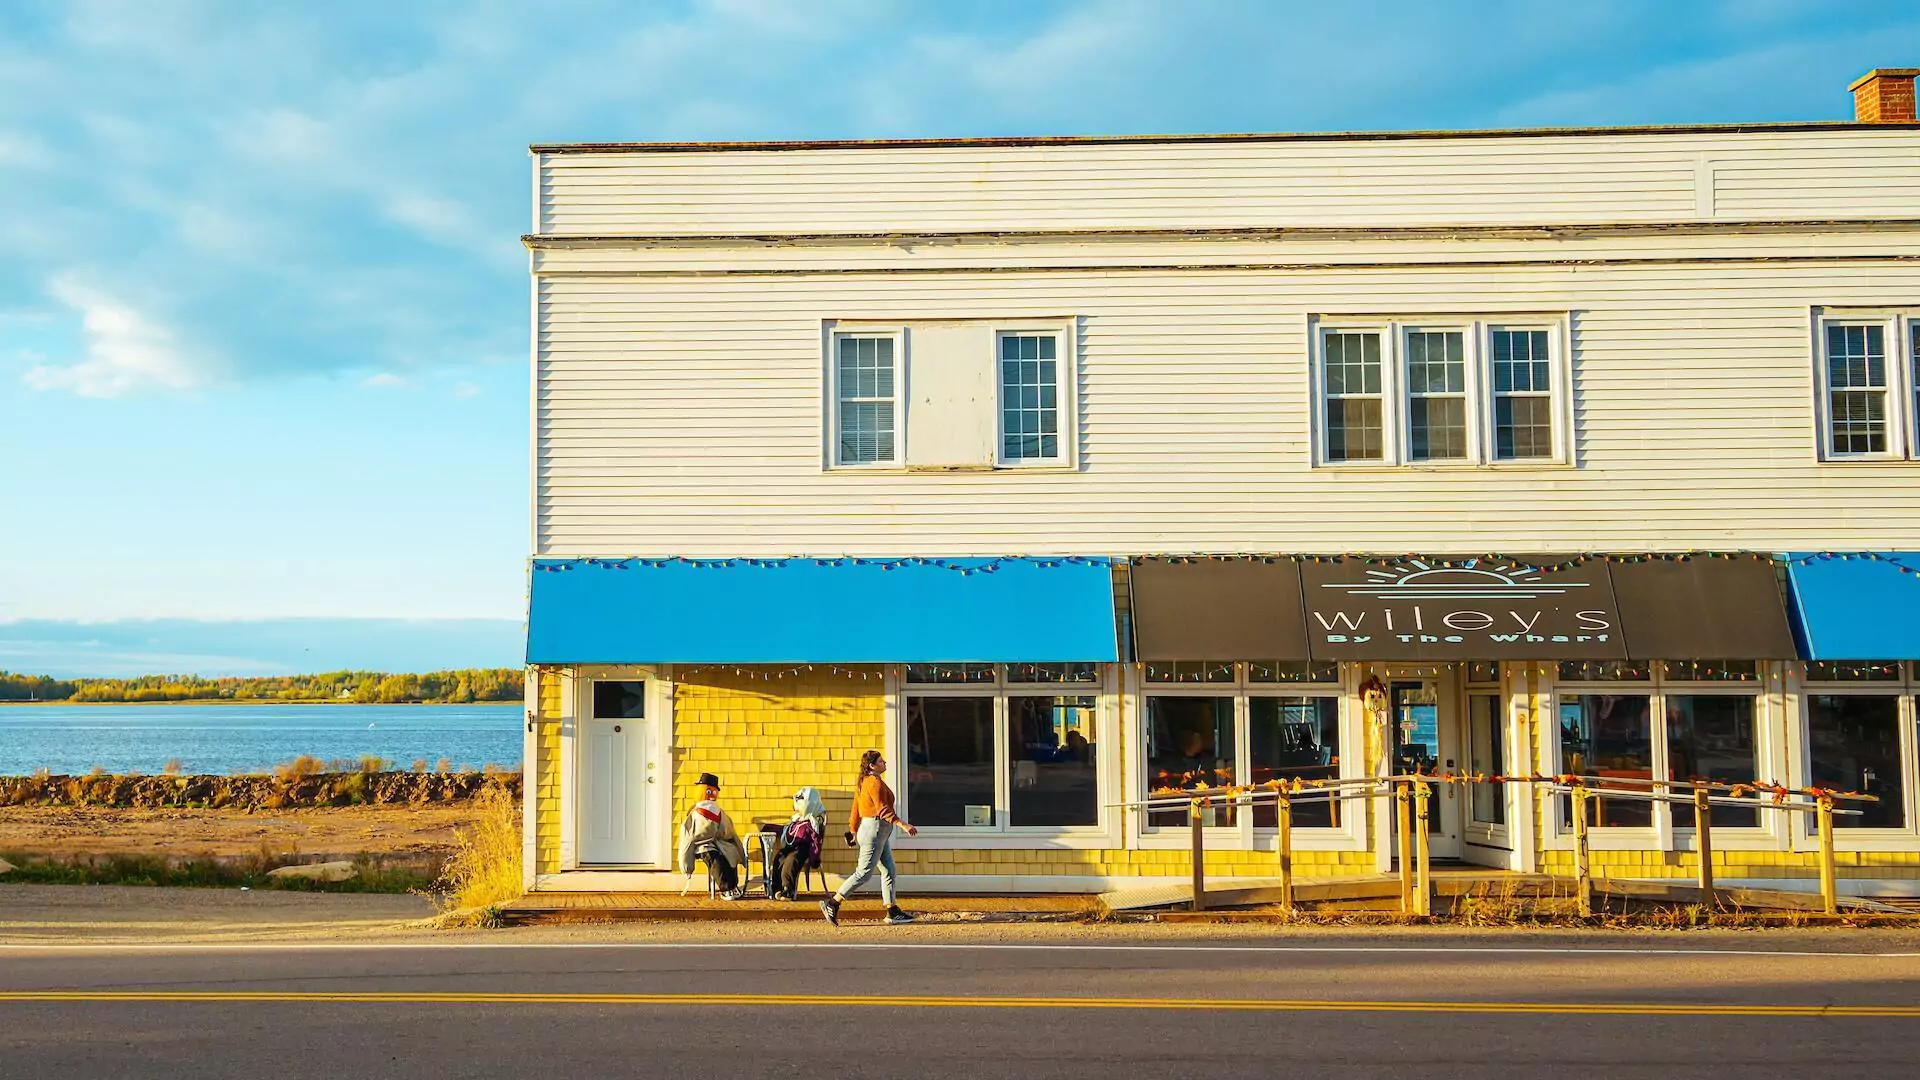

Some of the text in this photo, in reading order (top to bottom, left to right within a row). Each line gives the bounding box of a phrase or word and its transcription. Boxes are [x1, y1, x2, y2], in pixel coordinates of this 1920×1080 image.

[1326, 634, 1610, 643] By The Wharf
